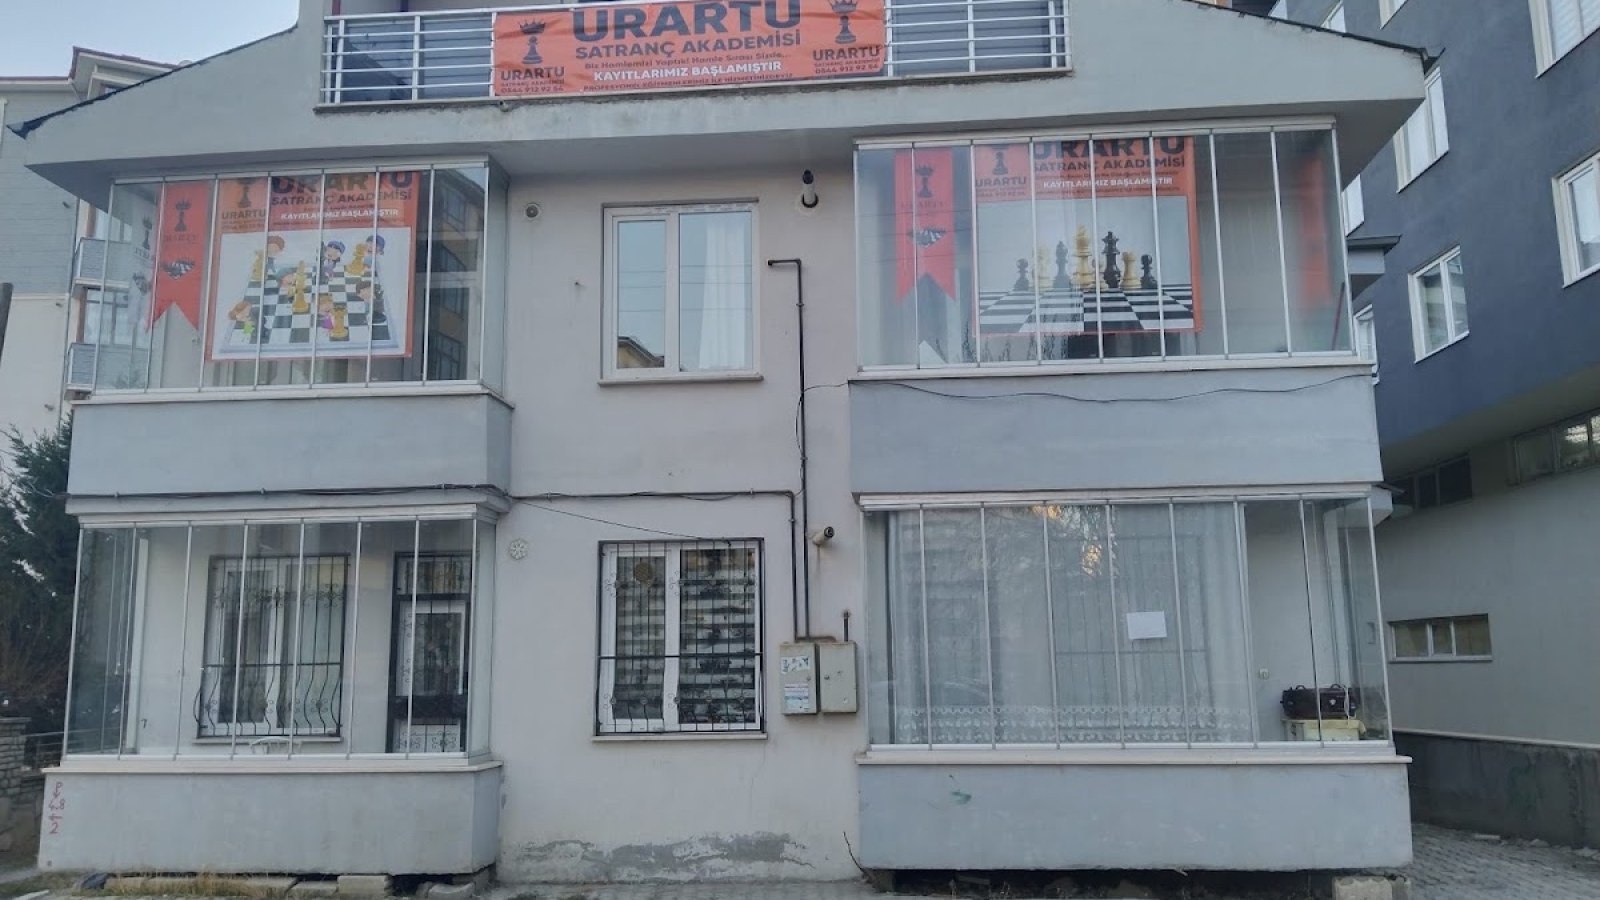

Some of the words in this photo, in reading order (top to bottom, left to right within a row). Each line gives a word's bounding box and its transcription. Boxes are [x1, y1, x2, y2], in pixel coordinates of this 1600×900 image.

[573, 0, 801, 42] URARTU
[575, 41, 675, 59] SATRANÇ
[682, 29, 801, 53] AKADEMİSİ
[812, 45, 880, 60] URARTU
[501, 66, 565, 81] URARTU
[594, 67, 689, 81] KAYITLARIMIZ
[691, 61, 782, 77] BAŞLAMIŞTIR
[976, 175, 1027, 187] URARTU
[222, 208, 267, 220] URARTU
[341, 207, 399, 219] BAŞLAMŞTIR
[49, 821, 59, 835] 2
